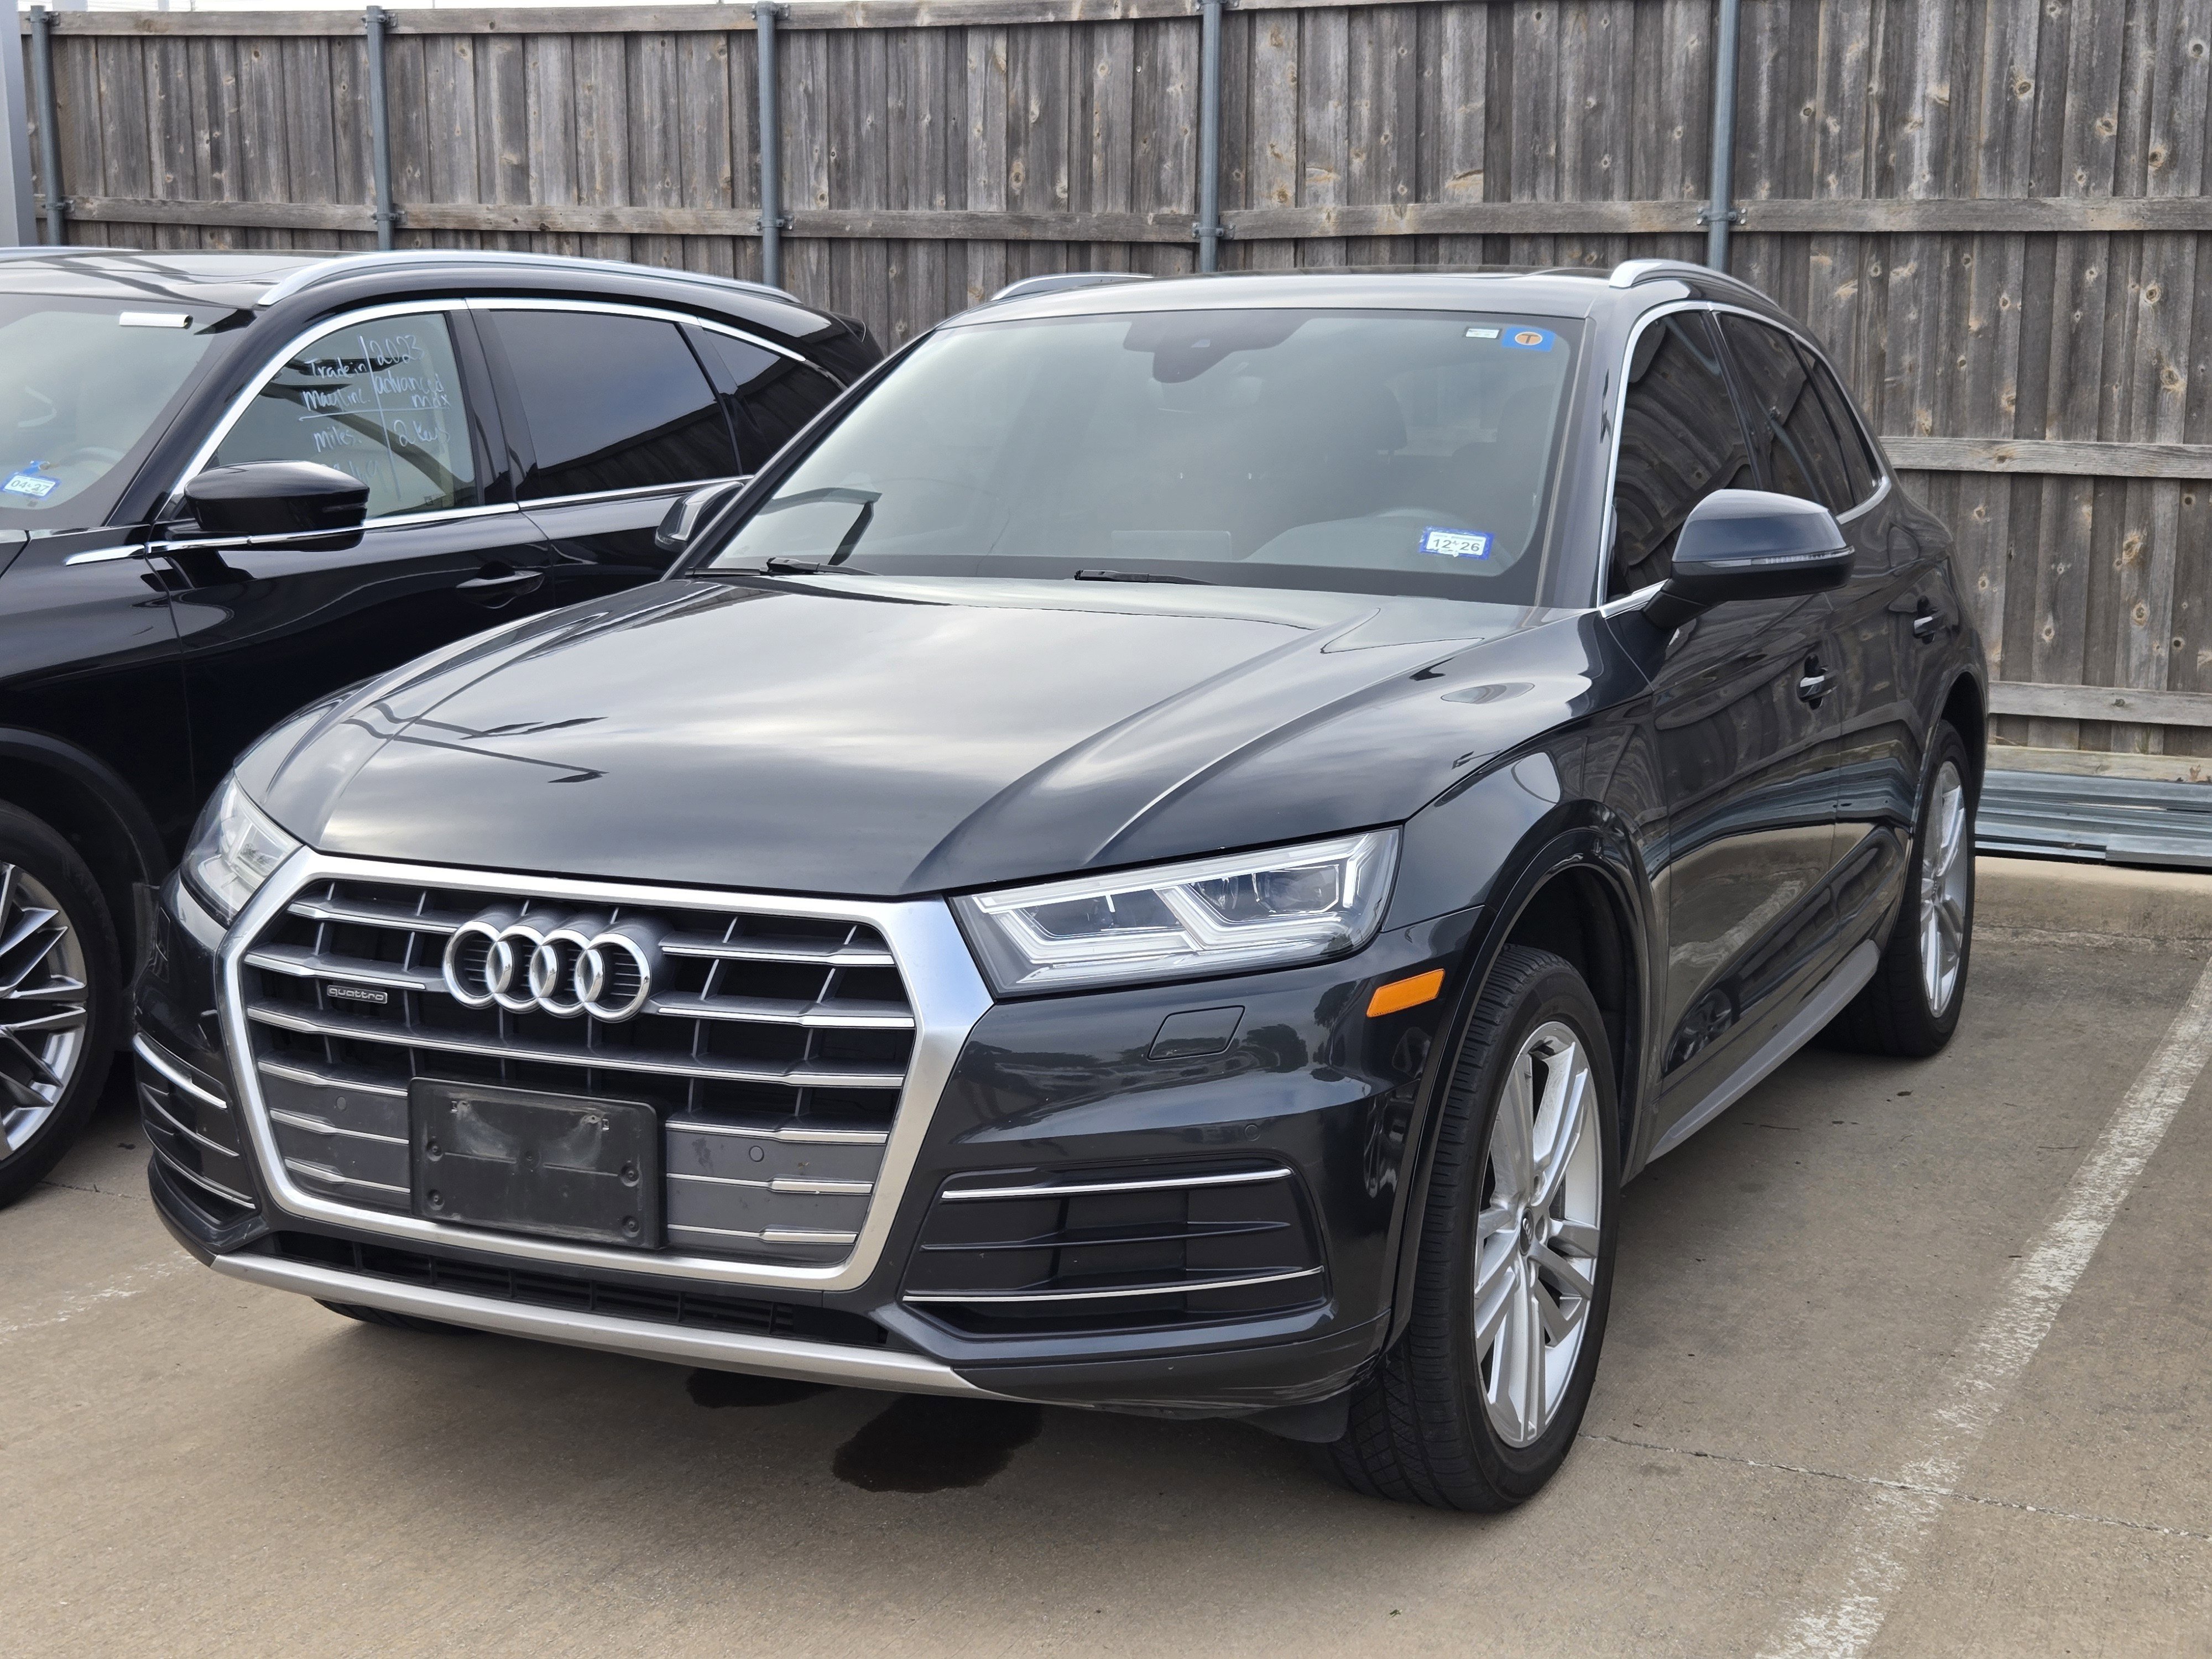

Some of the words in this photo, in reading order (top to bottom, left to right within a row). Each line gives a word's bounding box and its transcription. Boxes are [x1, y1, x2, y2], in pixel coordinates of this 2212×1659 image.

[370, 335, 425, 365] 2023
[304, 356, 353, 379] Trade
[393, 419, 416, 447] 2
[1433, 538, 1452, 549] 12
[1459, 541, 1481, 552] 26
[328, 988, 384, 1001] quattro
